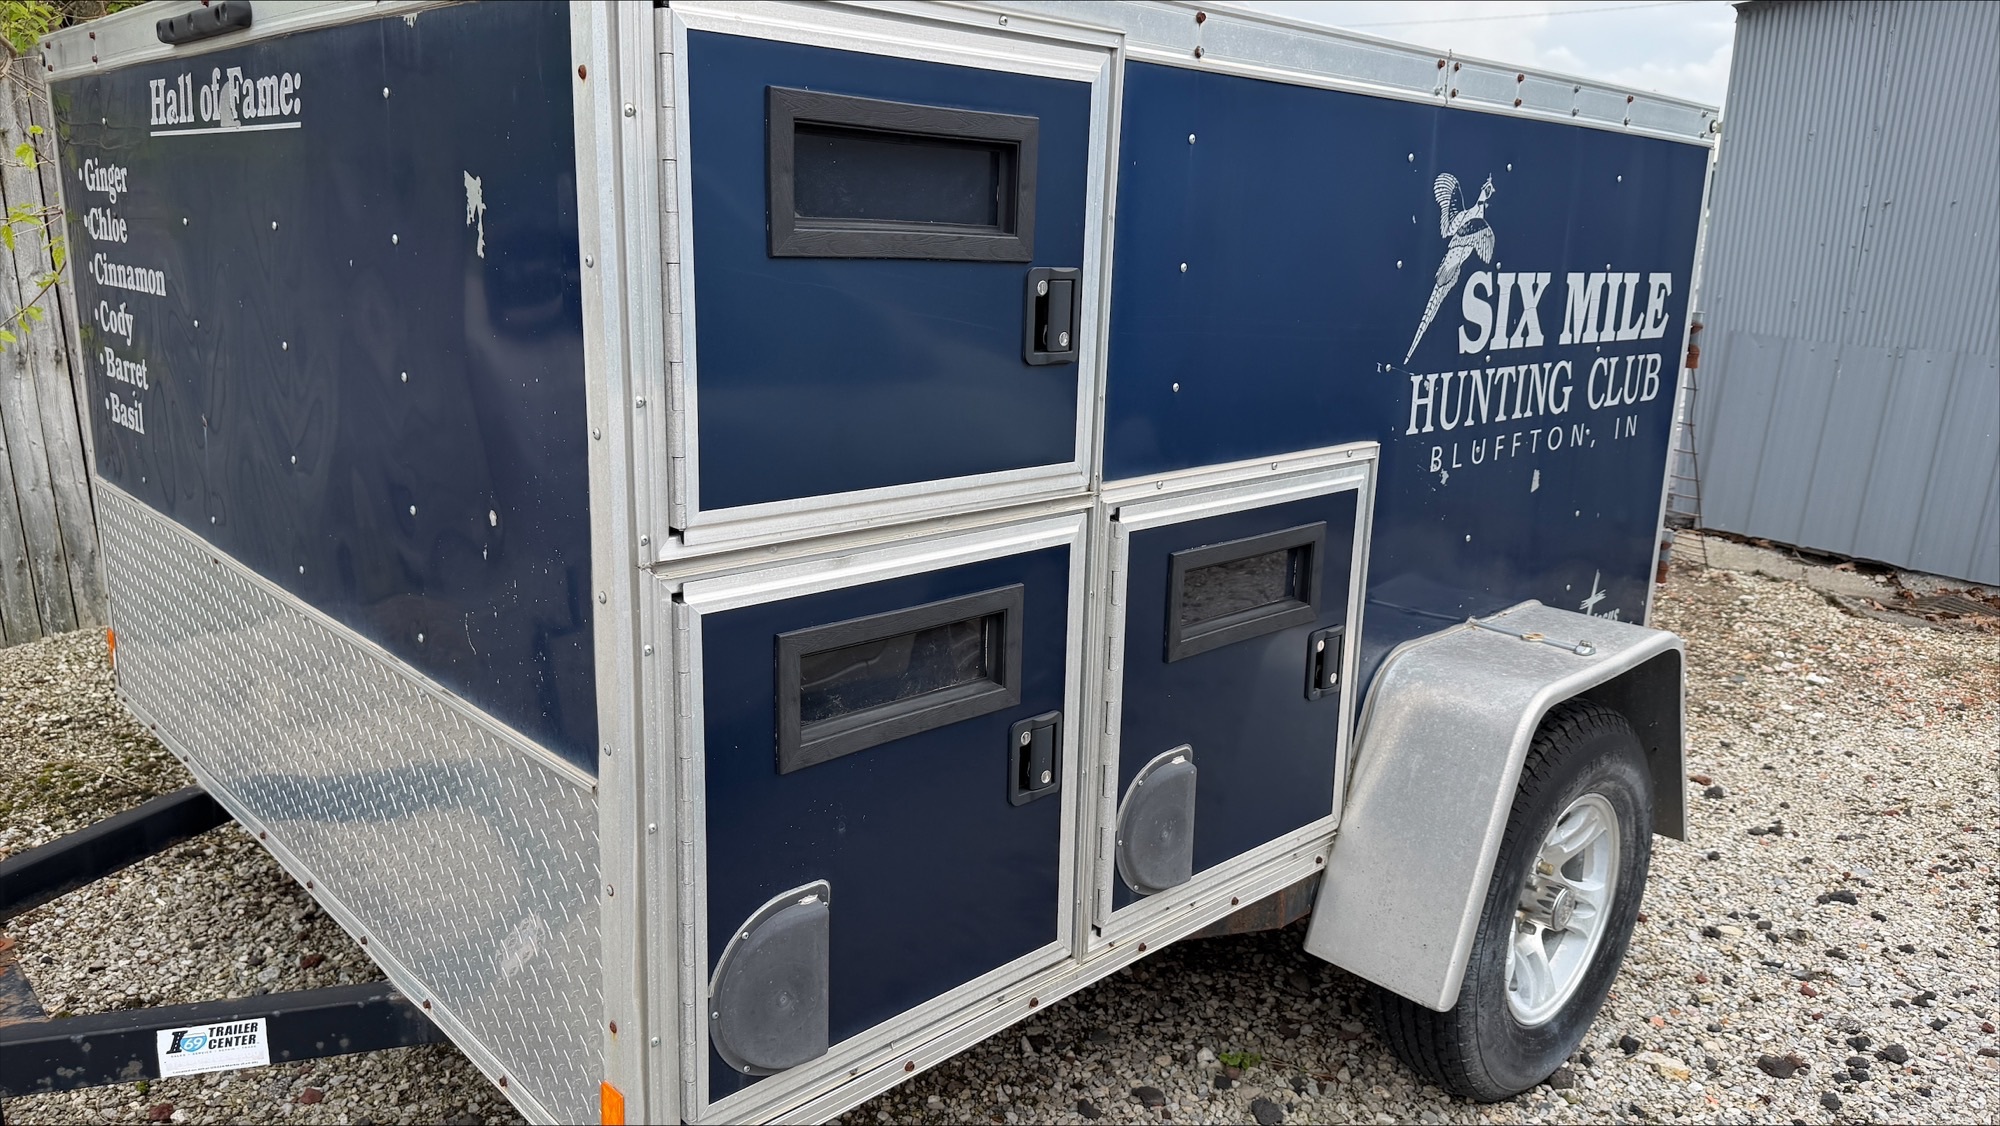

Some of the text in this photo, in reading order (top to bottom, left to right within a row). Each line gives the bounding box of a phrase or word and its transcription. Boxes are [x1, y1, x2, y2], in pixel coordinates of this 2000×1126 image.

[150, 66, 302, 126] Hall of Fame:
[84, 157, 128, 204] Ginger
[89, 207, 128, 244] Chloe
[94, 252, 167, 297] Cinnamon
[100, 300, 134, 347] Cody
[1458, 270, 1673, 355] SIX MILE
[104, 346, 149, 391] Barret
[109, 391, 146, 435] Basil
[1405, 352, 1663, 436] HUNTING CLUB
[1429, 414, 1638, 473] BLUFFTON, IN
[207, 1034, 257, 1050] CENTER
[208, 1022, 259, 1038] TRAILER
